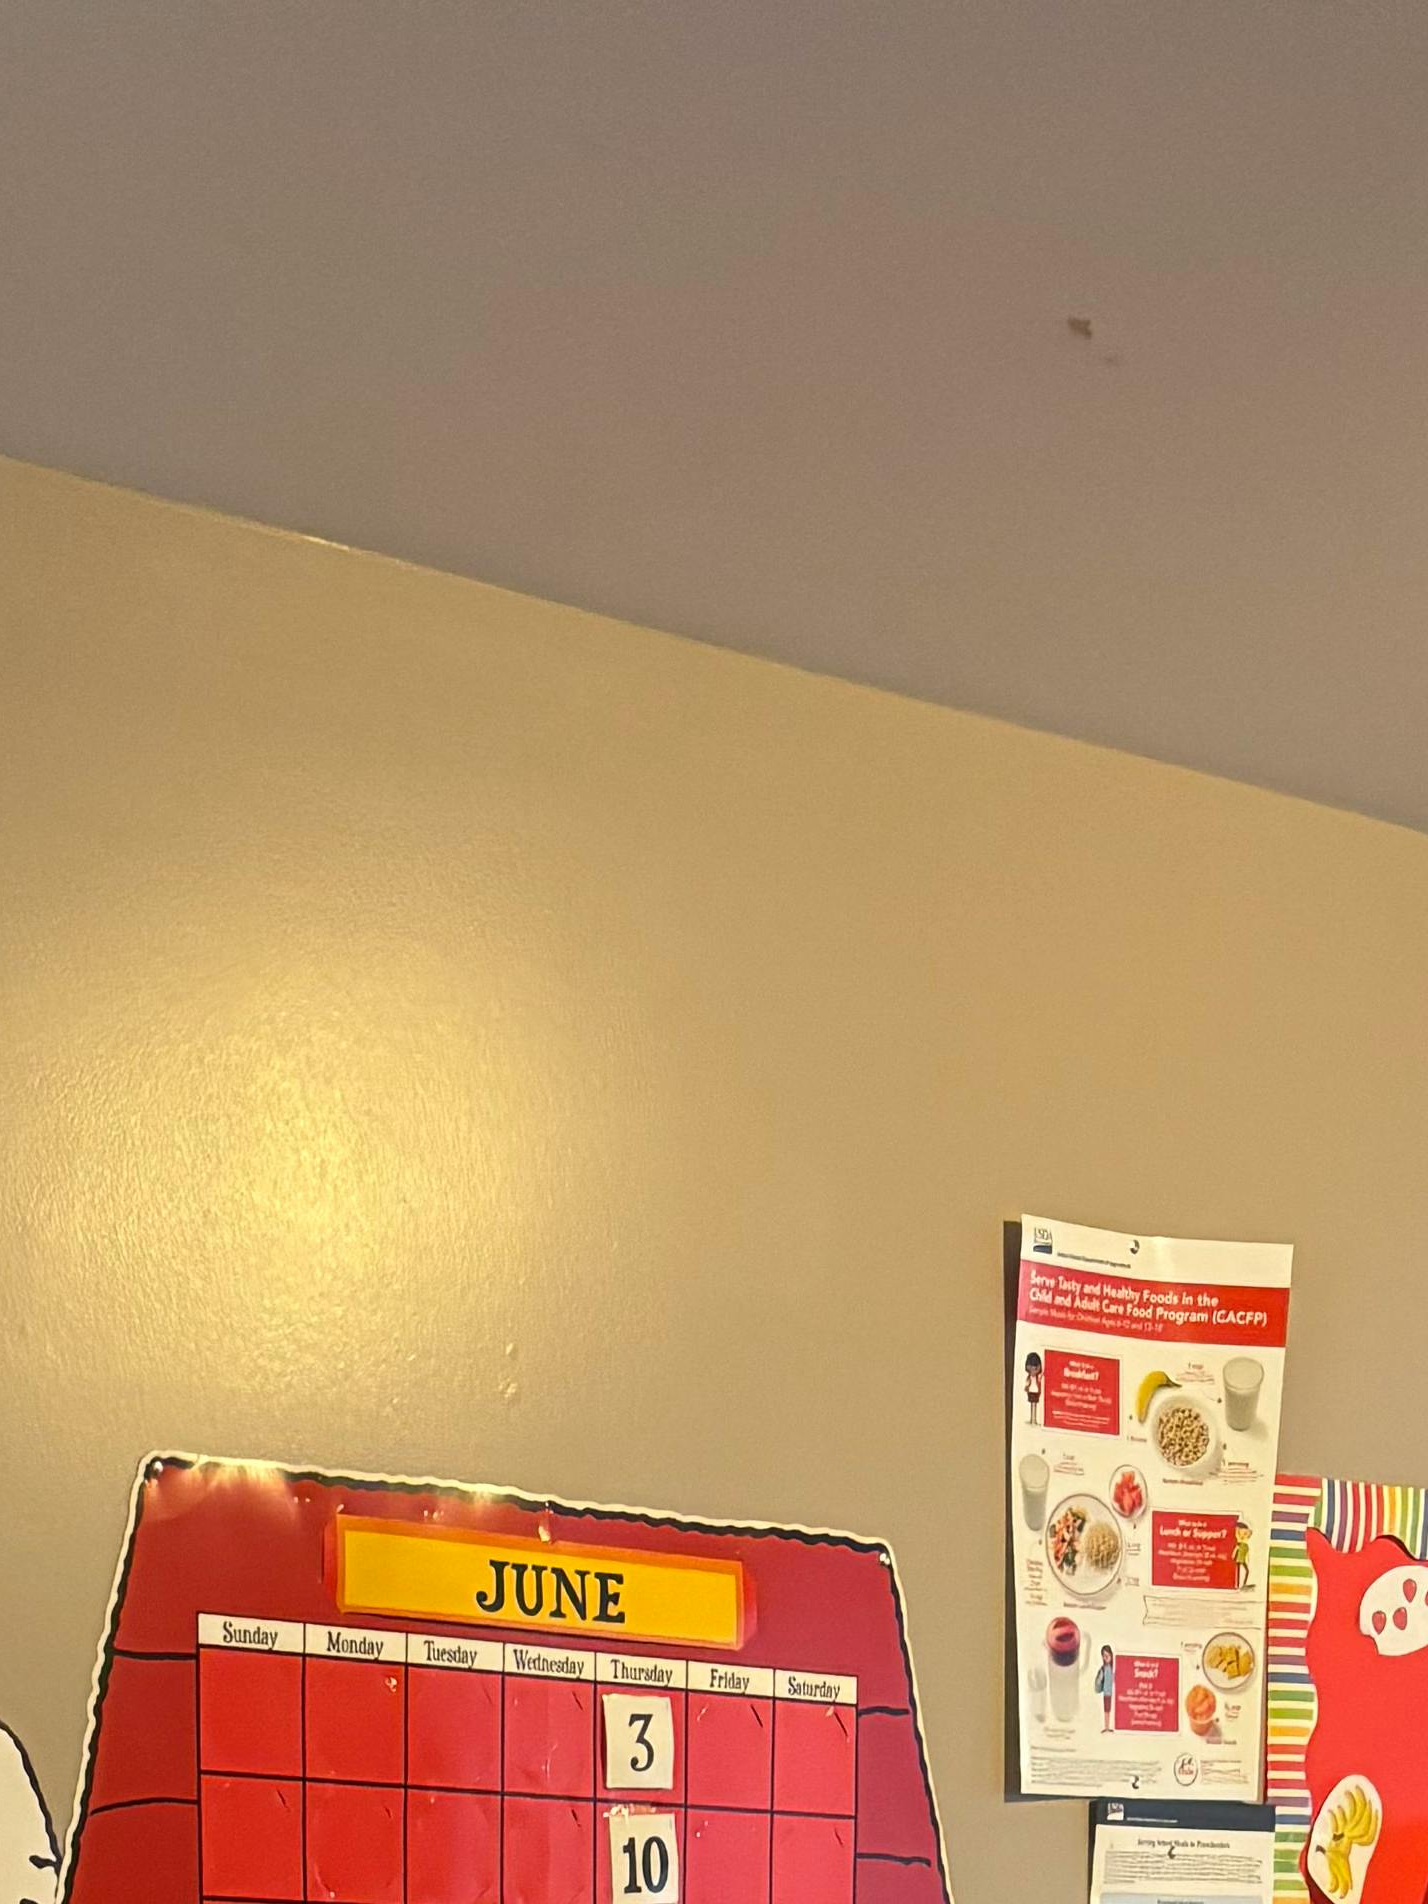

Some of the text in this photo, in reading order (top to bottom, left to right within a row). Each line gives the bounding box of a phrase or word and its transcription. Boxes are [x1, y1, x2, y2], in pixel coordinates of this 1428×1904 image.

[1029, 1270, 1219, 1307] Serve Tasty and Healthy Foods in the
[1029, 1288, 1267, 1327] Child and Adult Care Food Program (CACFP)
[475, 1558, 626, 1624] JUNE
[221, 1619, 842, 1703] Sunday Monday Tuesday Wednesday Thursday Friday Saturday
[629, 1712, 655, 1774] 3
[621, 1836, 670, 1896] 10
